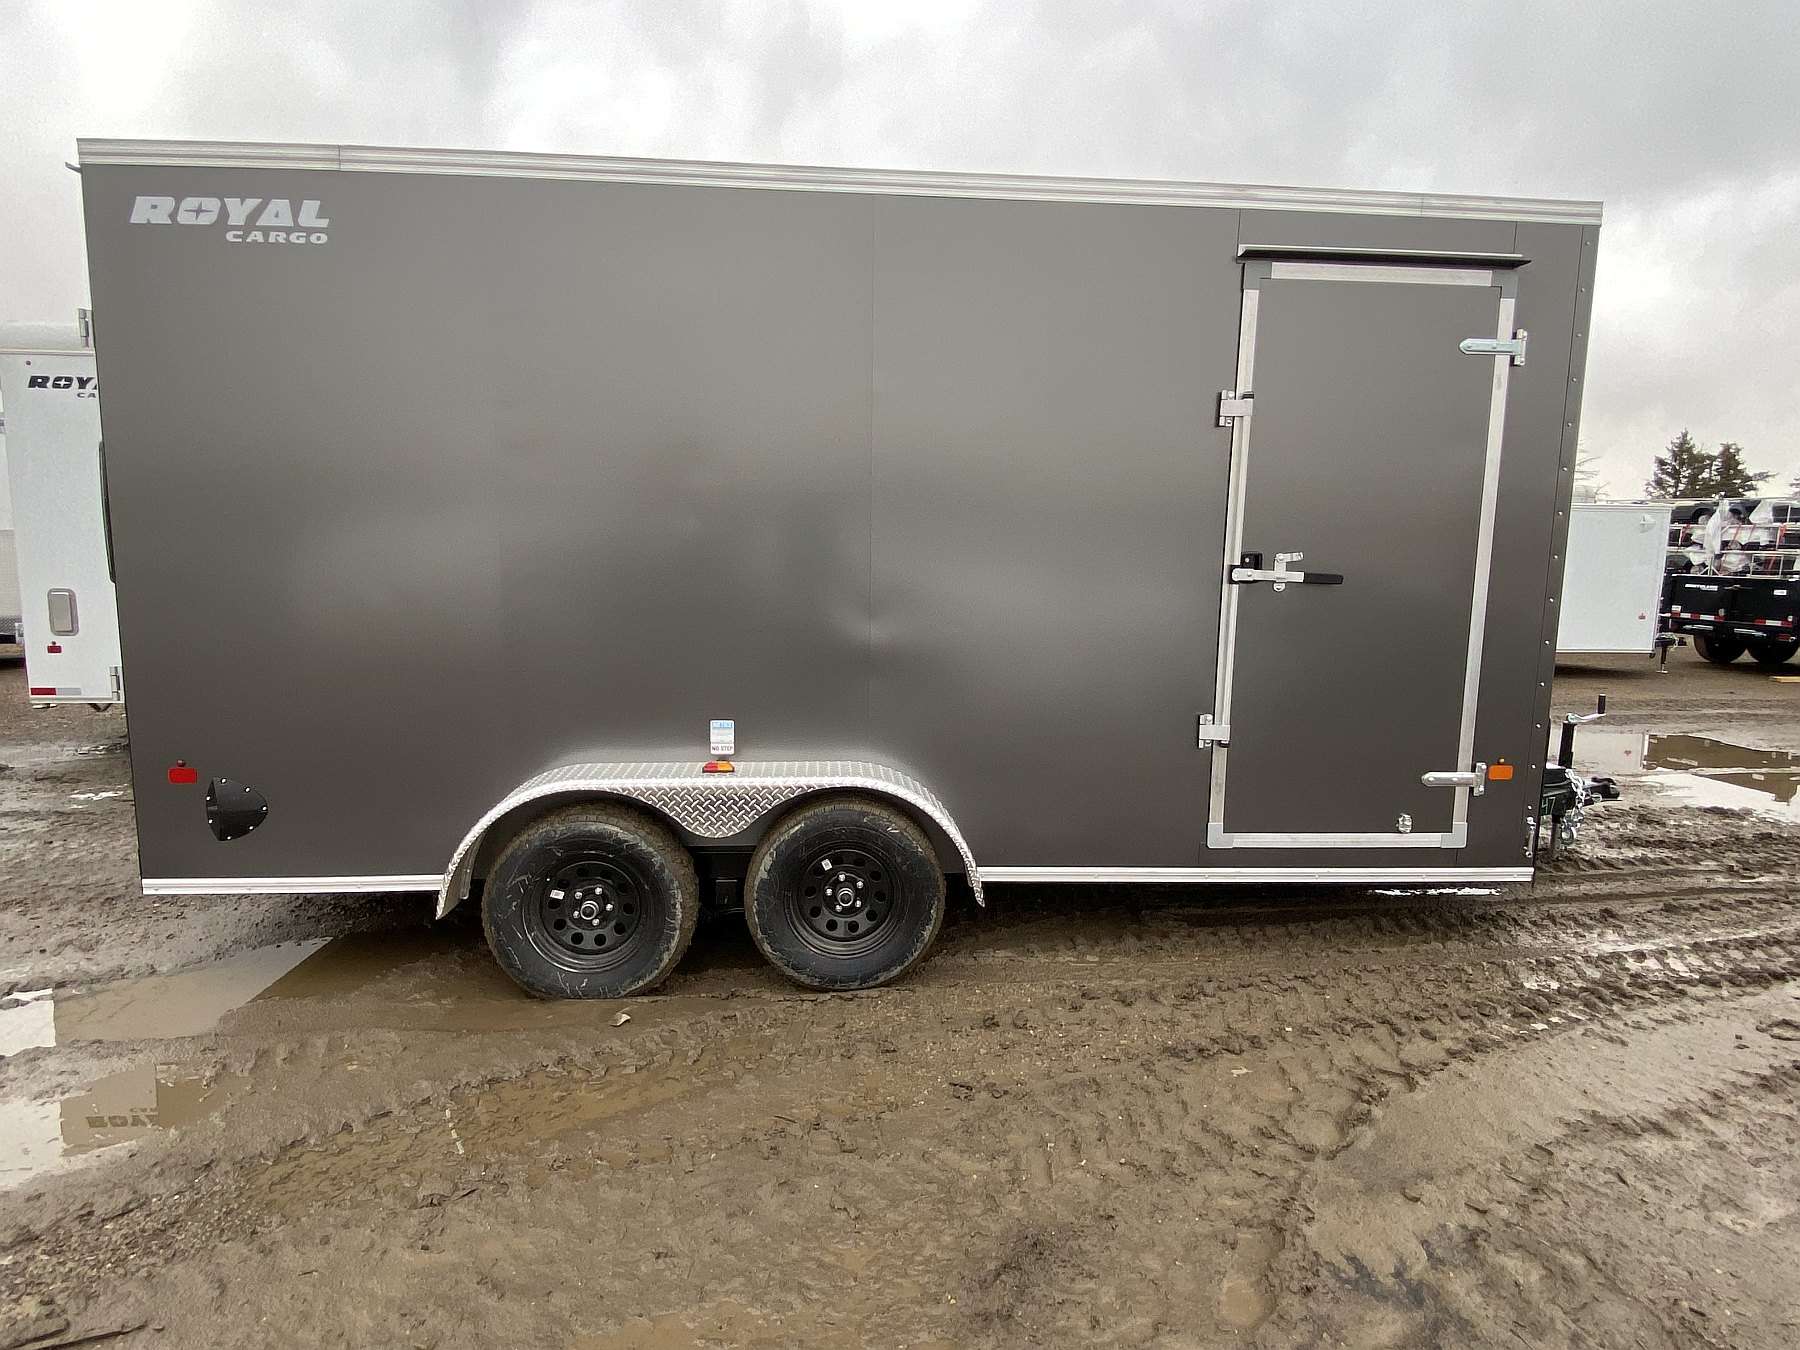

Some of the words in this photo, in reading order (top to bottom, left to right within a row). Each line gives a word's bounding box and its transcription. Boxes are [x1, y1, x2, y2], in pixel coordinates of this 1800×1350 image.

[129, 195, 330, 228] ROYAL
[225, 230, 329, 244] CARGO
[27, 375, 98, 390] ROY
